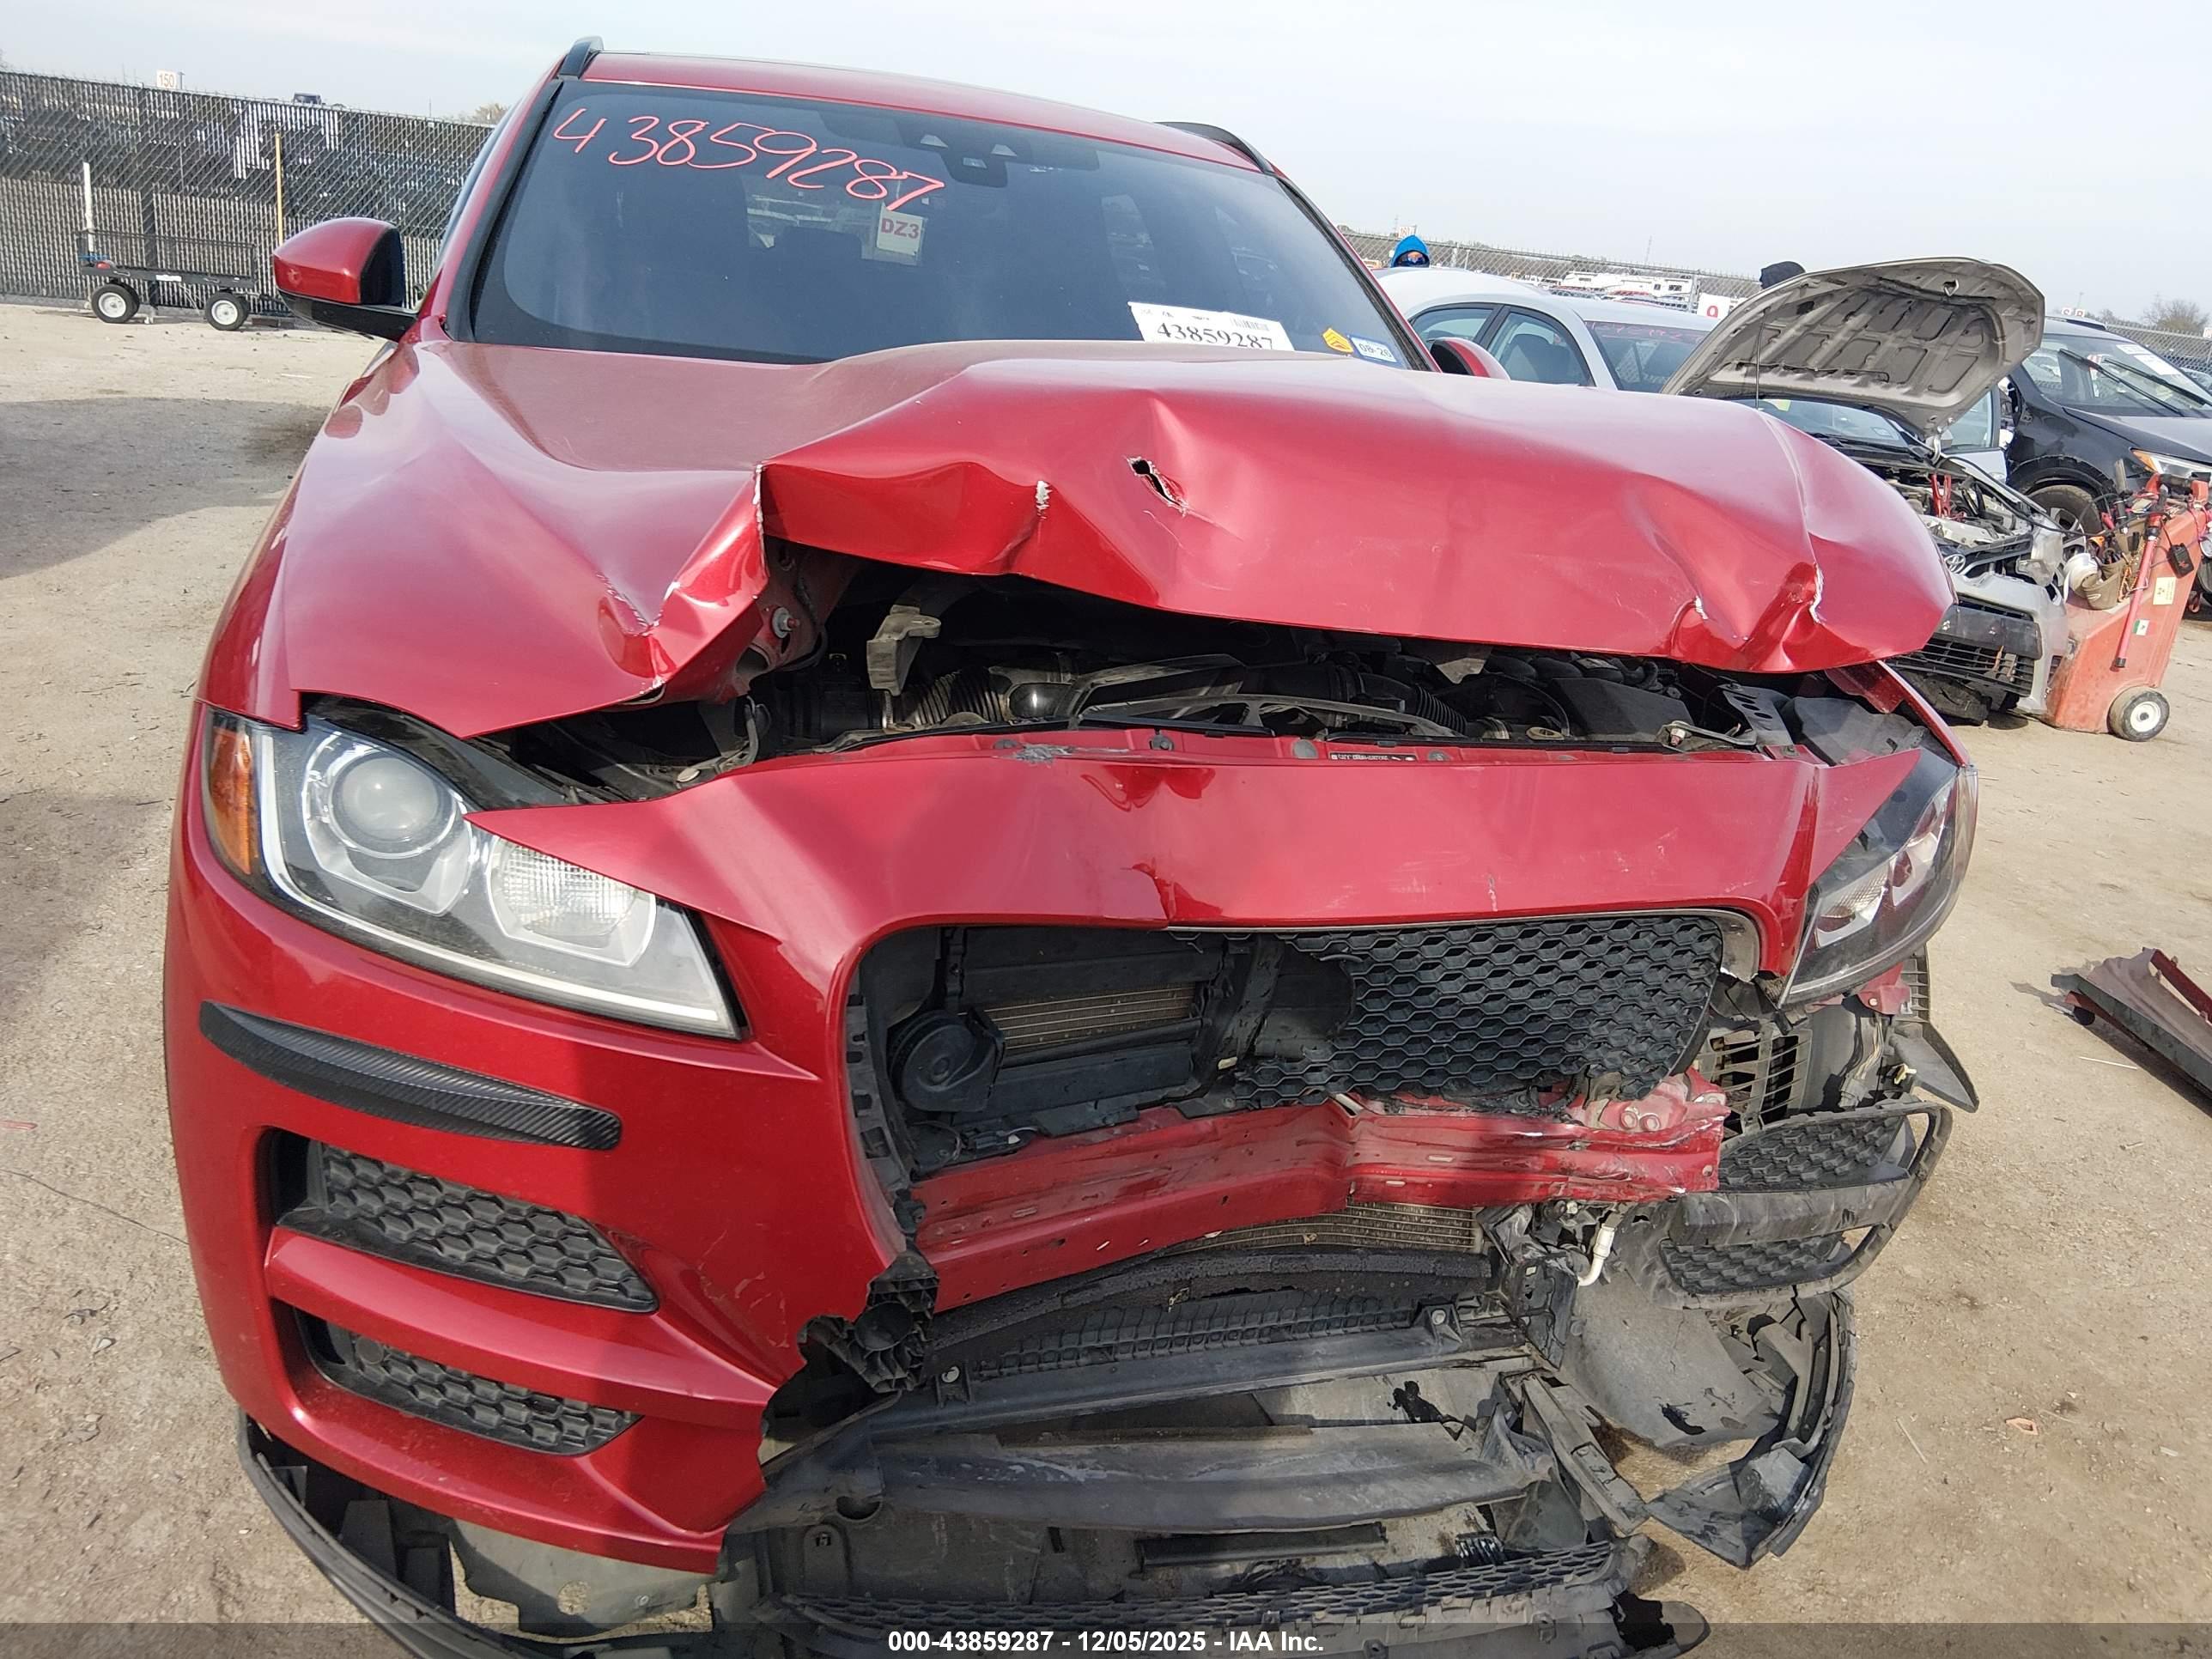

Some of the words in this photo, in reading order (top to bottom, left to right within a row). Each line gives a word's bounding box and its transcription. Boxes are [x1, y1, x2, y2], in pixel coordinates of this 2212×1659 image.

[160, 73, 174, 88] 150
[881, 217, 920, 240] DZ3
[1157, 322, 1273, 349] 43859287
